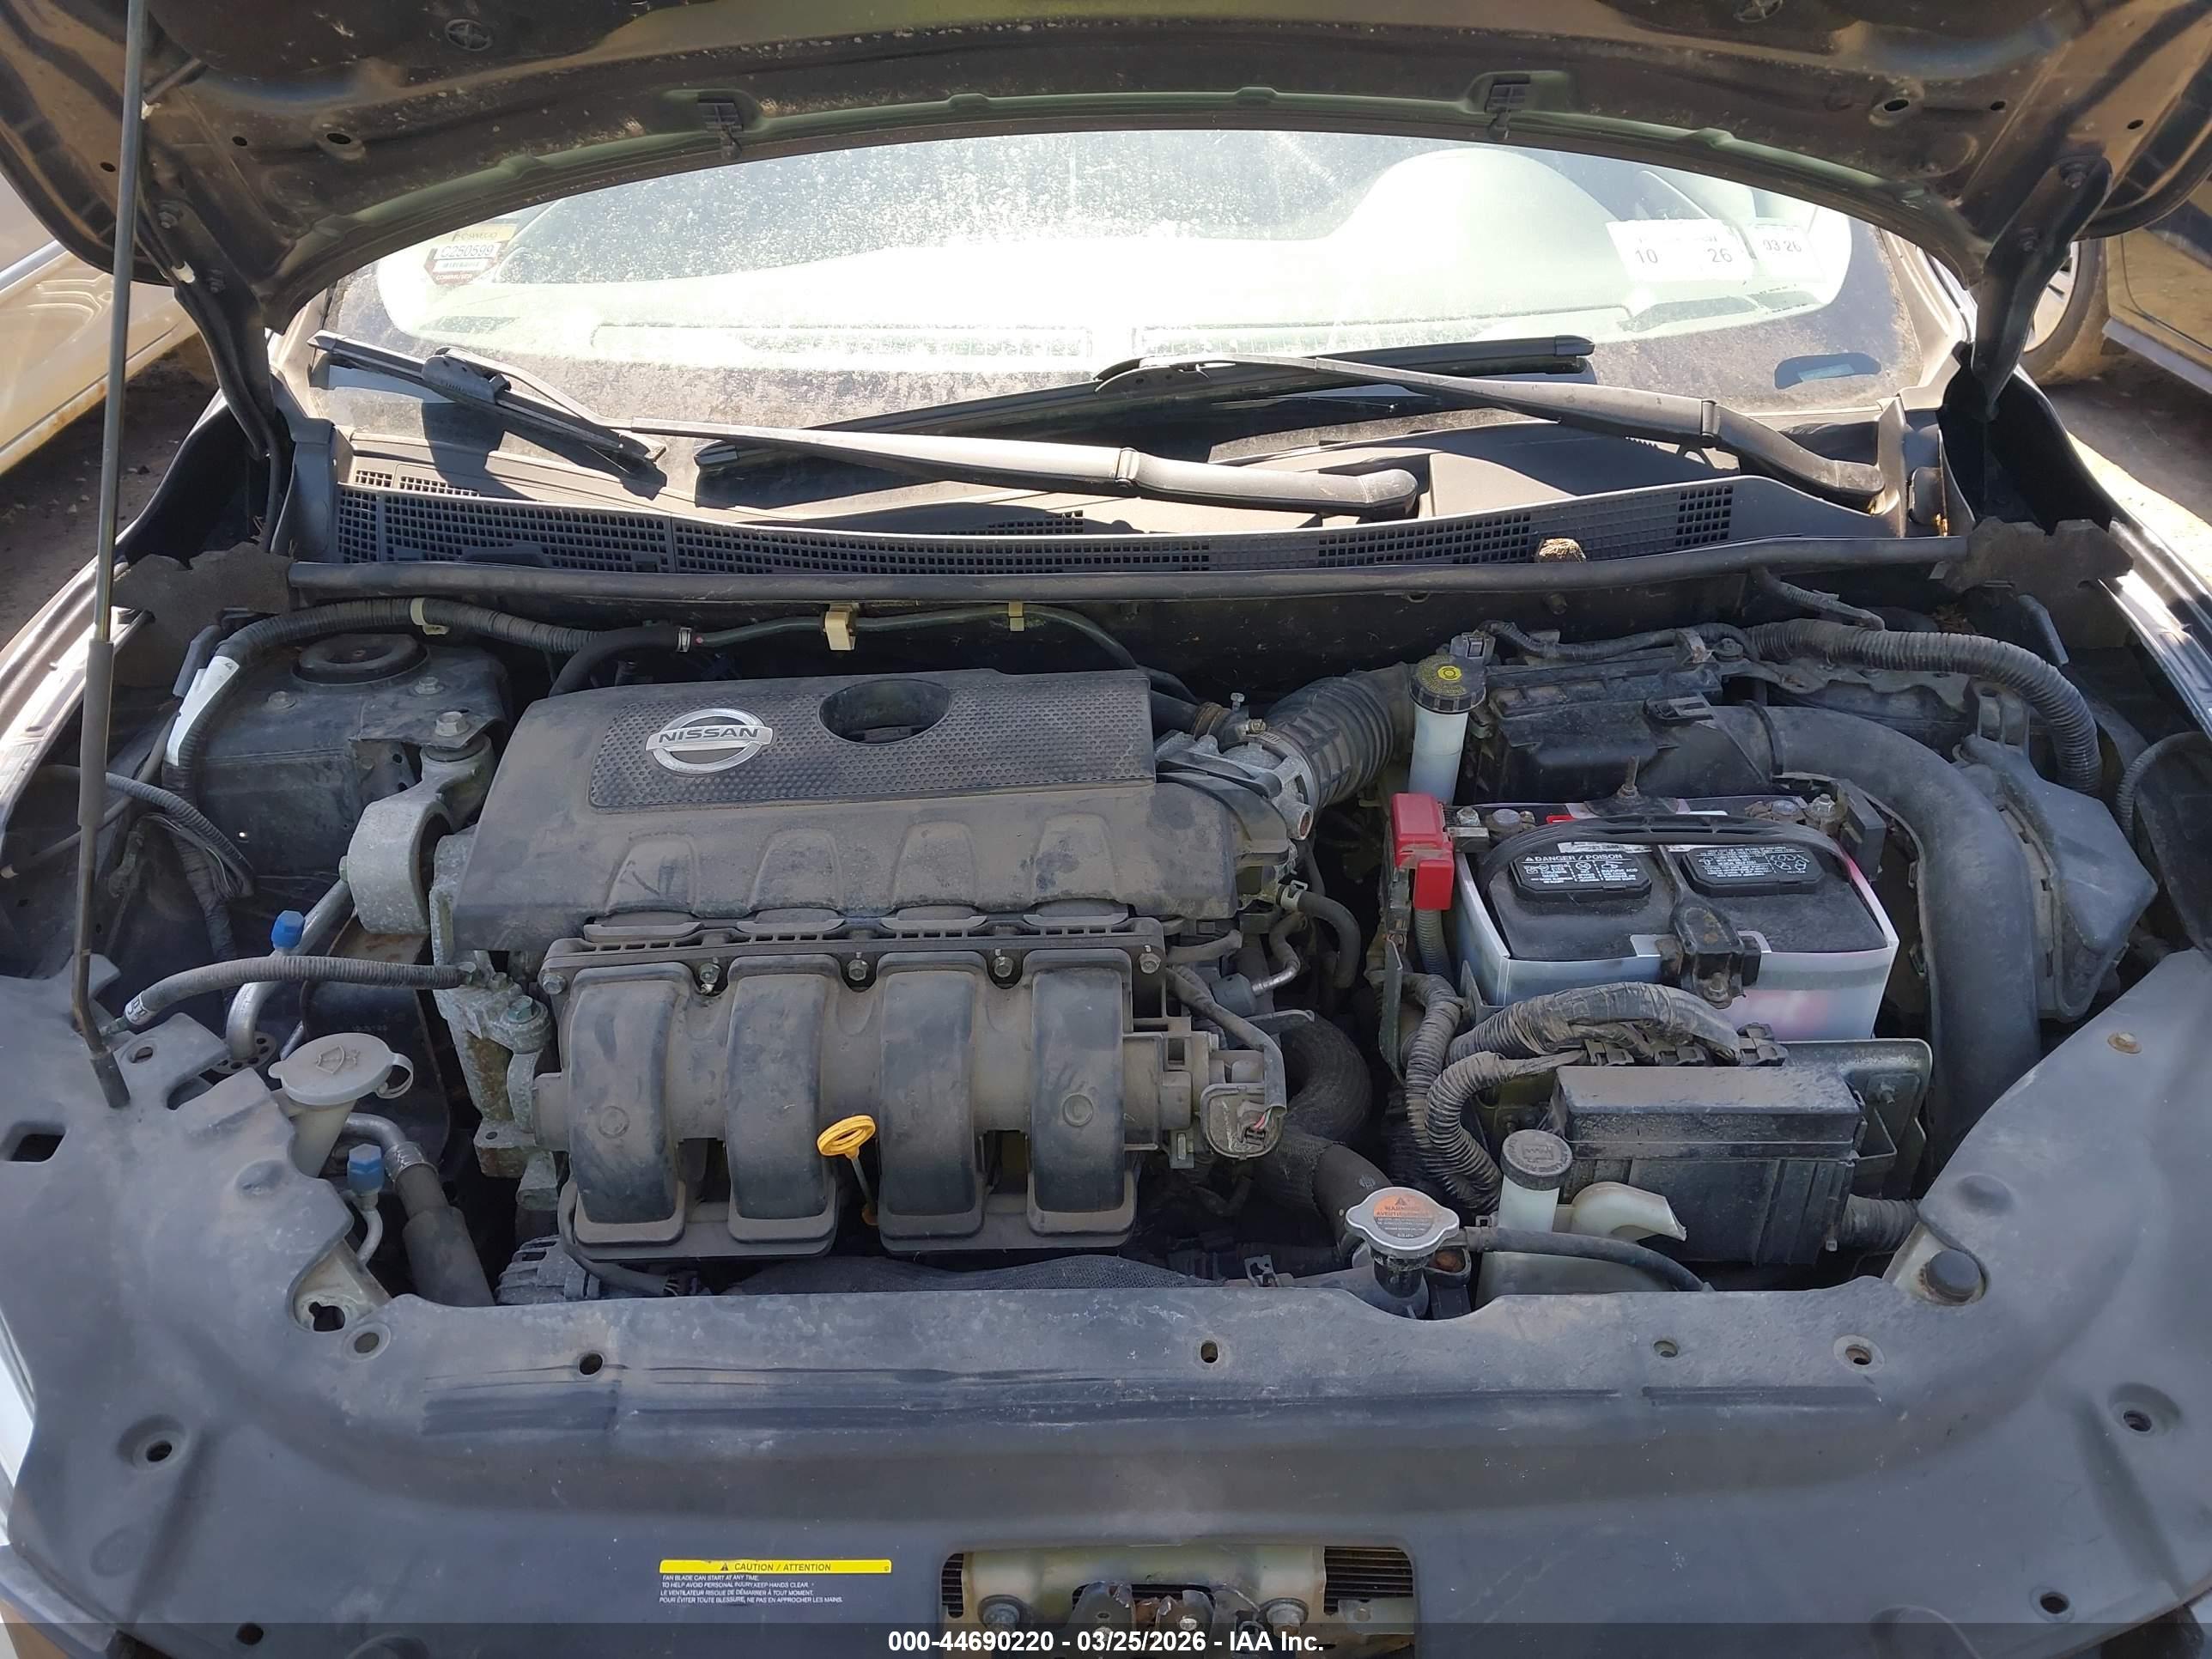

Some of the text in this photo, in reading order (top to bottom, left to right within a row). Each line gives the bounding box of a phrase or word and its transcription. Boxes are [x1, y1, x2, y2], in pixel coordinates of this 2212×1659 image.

[1635, 247, 1733, 264] 10 26
[659, 728, 759, 744] NISSAN
[734, 1563, 774, 1571] CAUTION
[783, 1563, 831, 1571] ATTENTION
